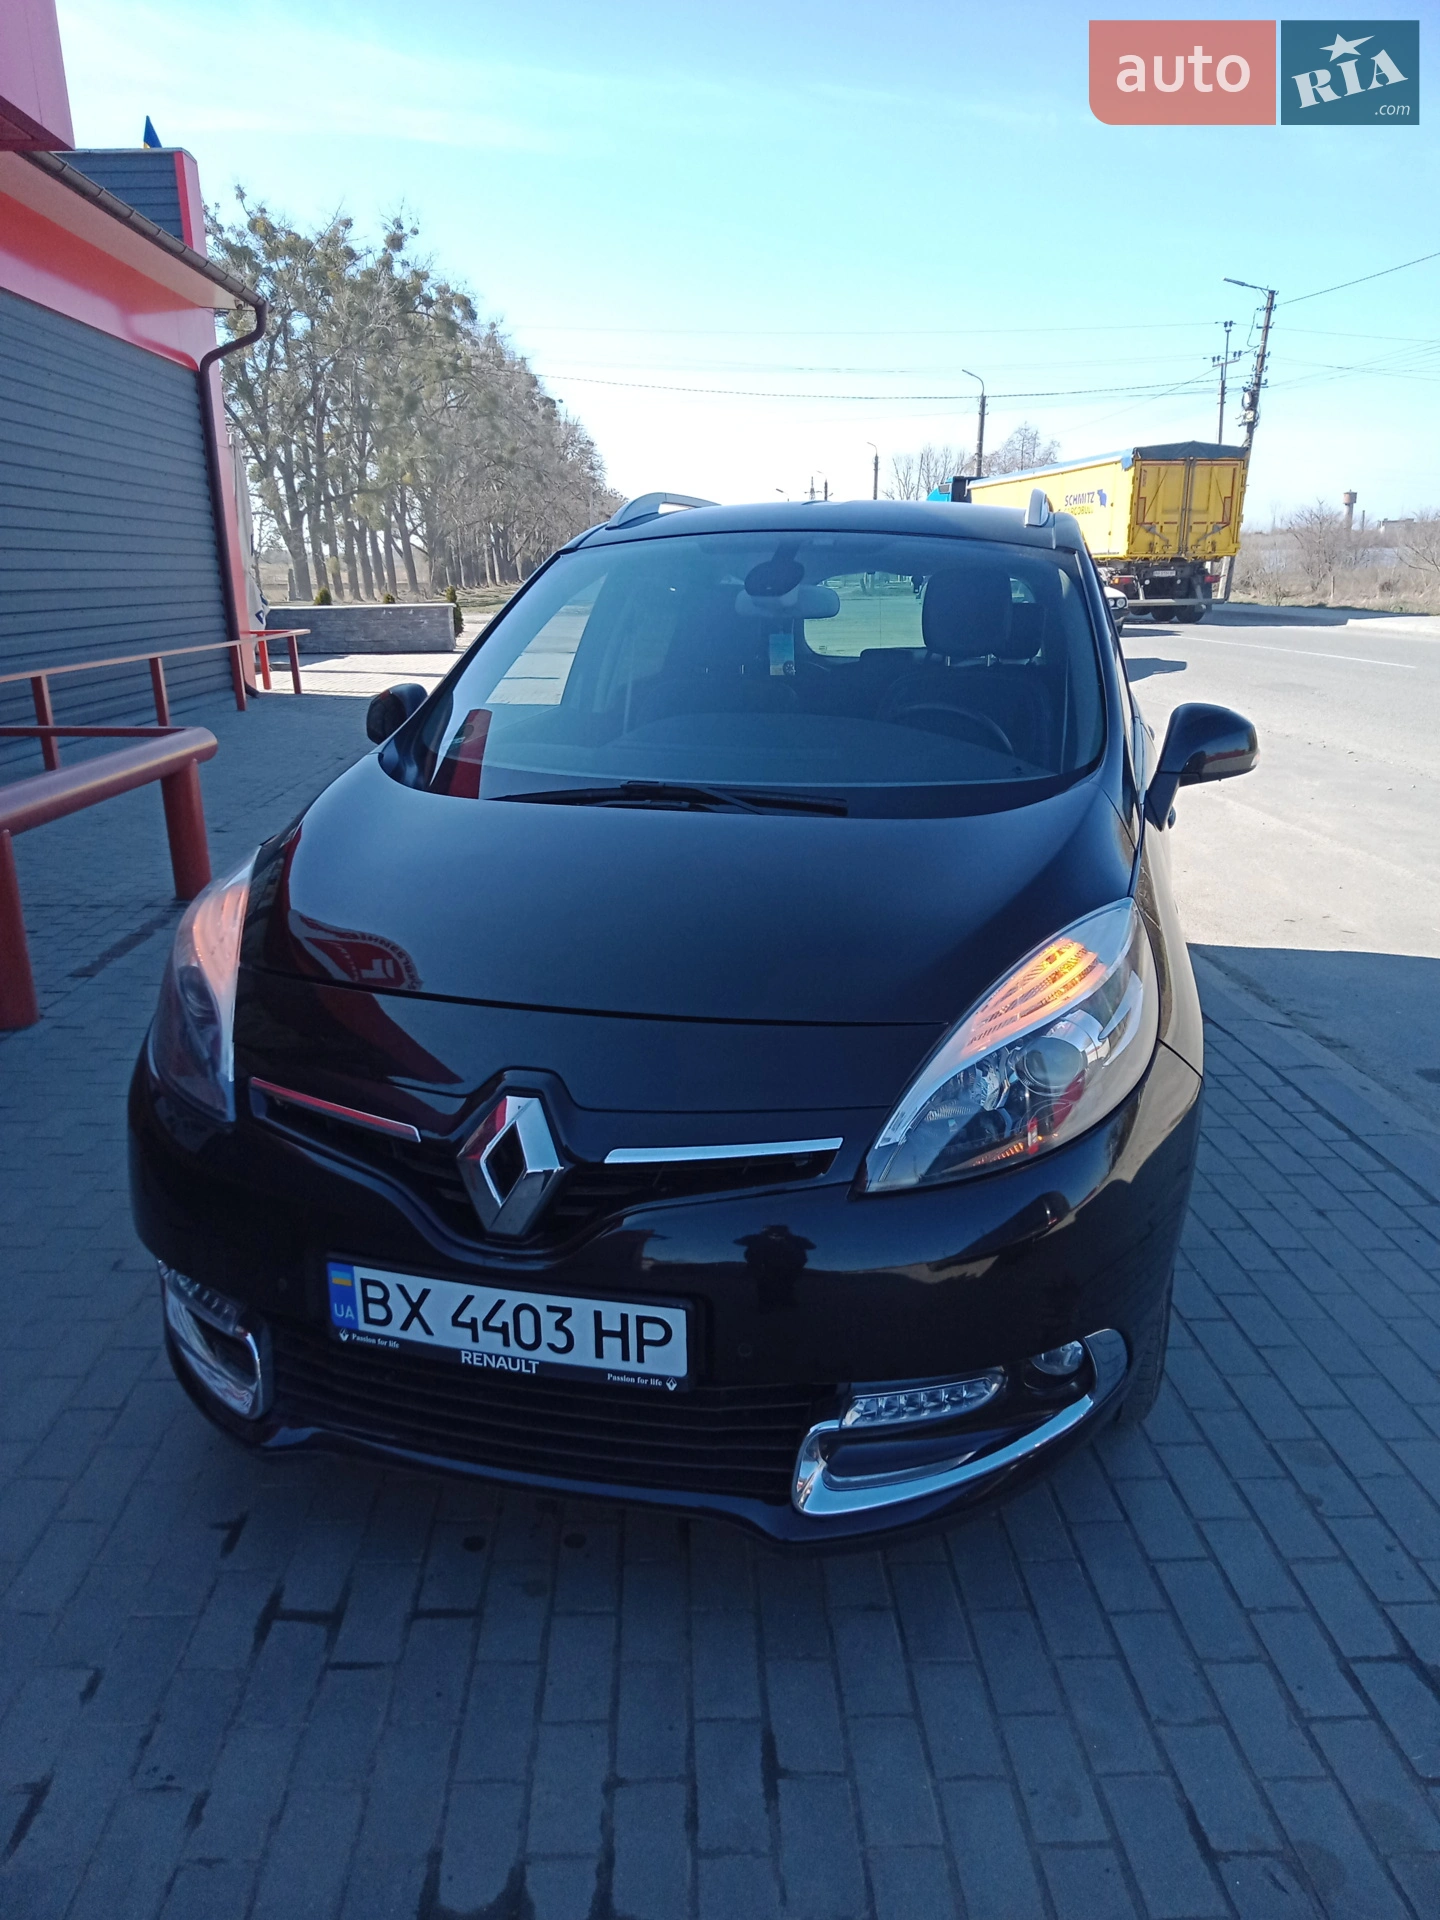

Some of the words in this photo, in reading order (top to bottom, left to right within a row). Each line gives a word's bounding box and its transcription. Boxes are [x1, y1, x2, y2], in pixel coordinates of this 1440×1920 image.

[1064, 491, 1096, 507] SCHMITZ
[333, 1302, 356, 1321] UA
[359, 1277, 435, 1336] BX
[450, 1294, 575, 1355] 4403
[593, 1309, 674, 1364] HP
[352, 1333, 377, 1344] Passion
[377, 1338, 388, 1346] for
[388, 1340, 400, 1349] life
[460, 1350, 540, 1374] RENAULT
[607, 1373, 636, 1384] Passion
[637, 1376, 649, 1385] for
[650, 1378, 663, 1387] life
